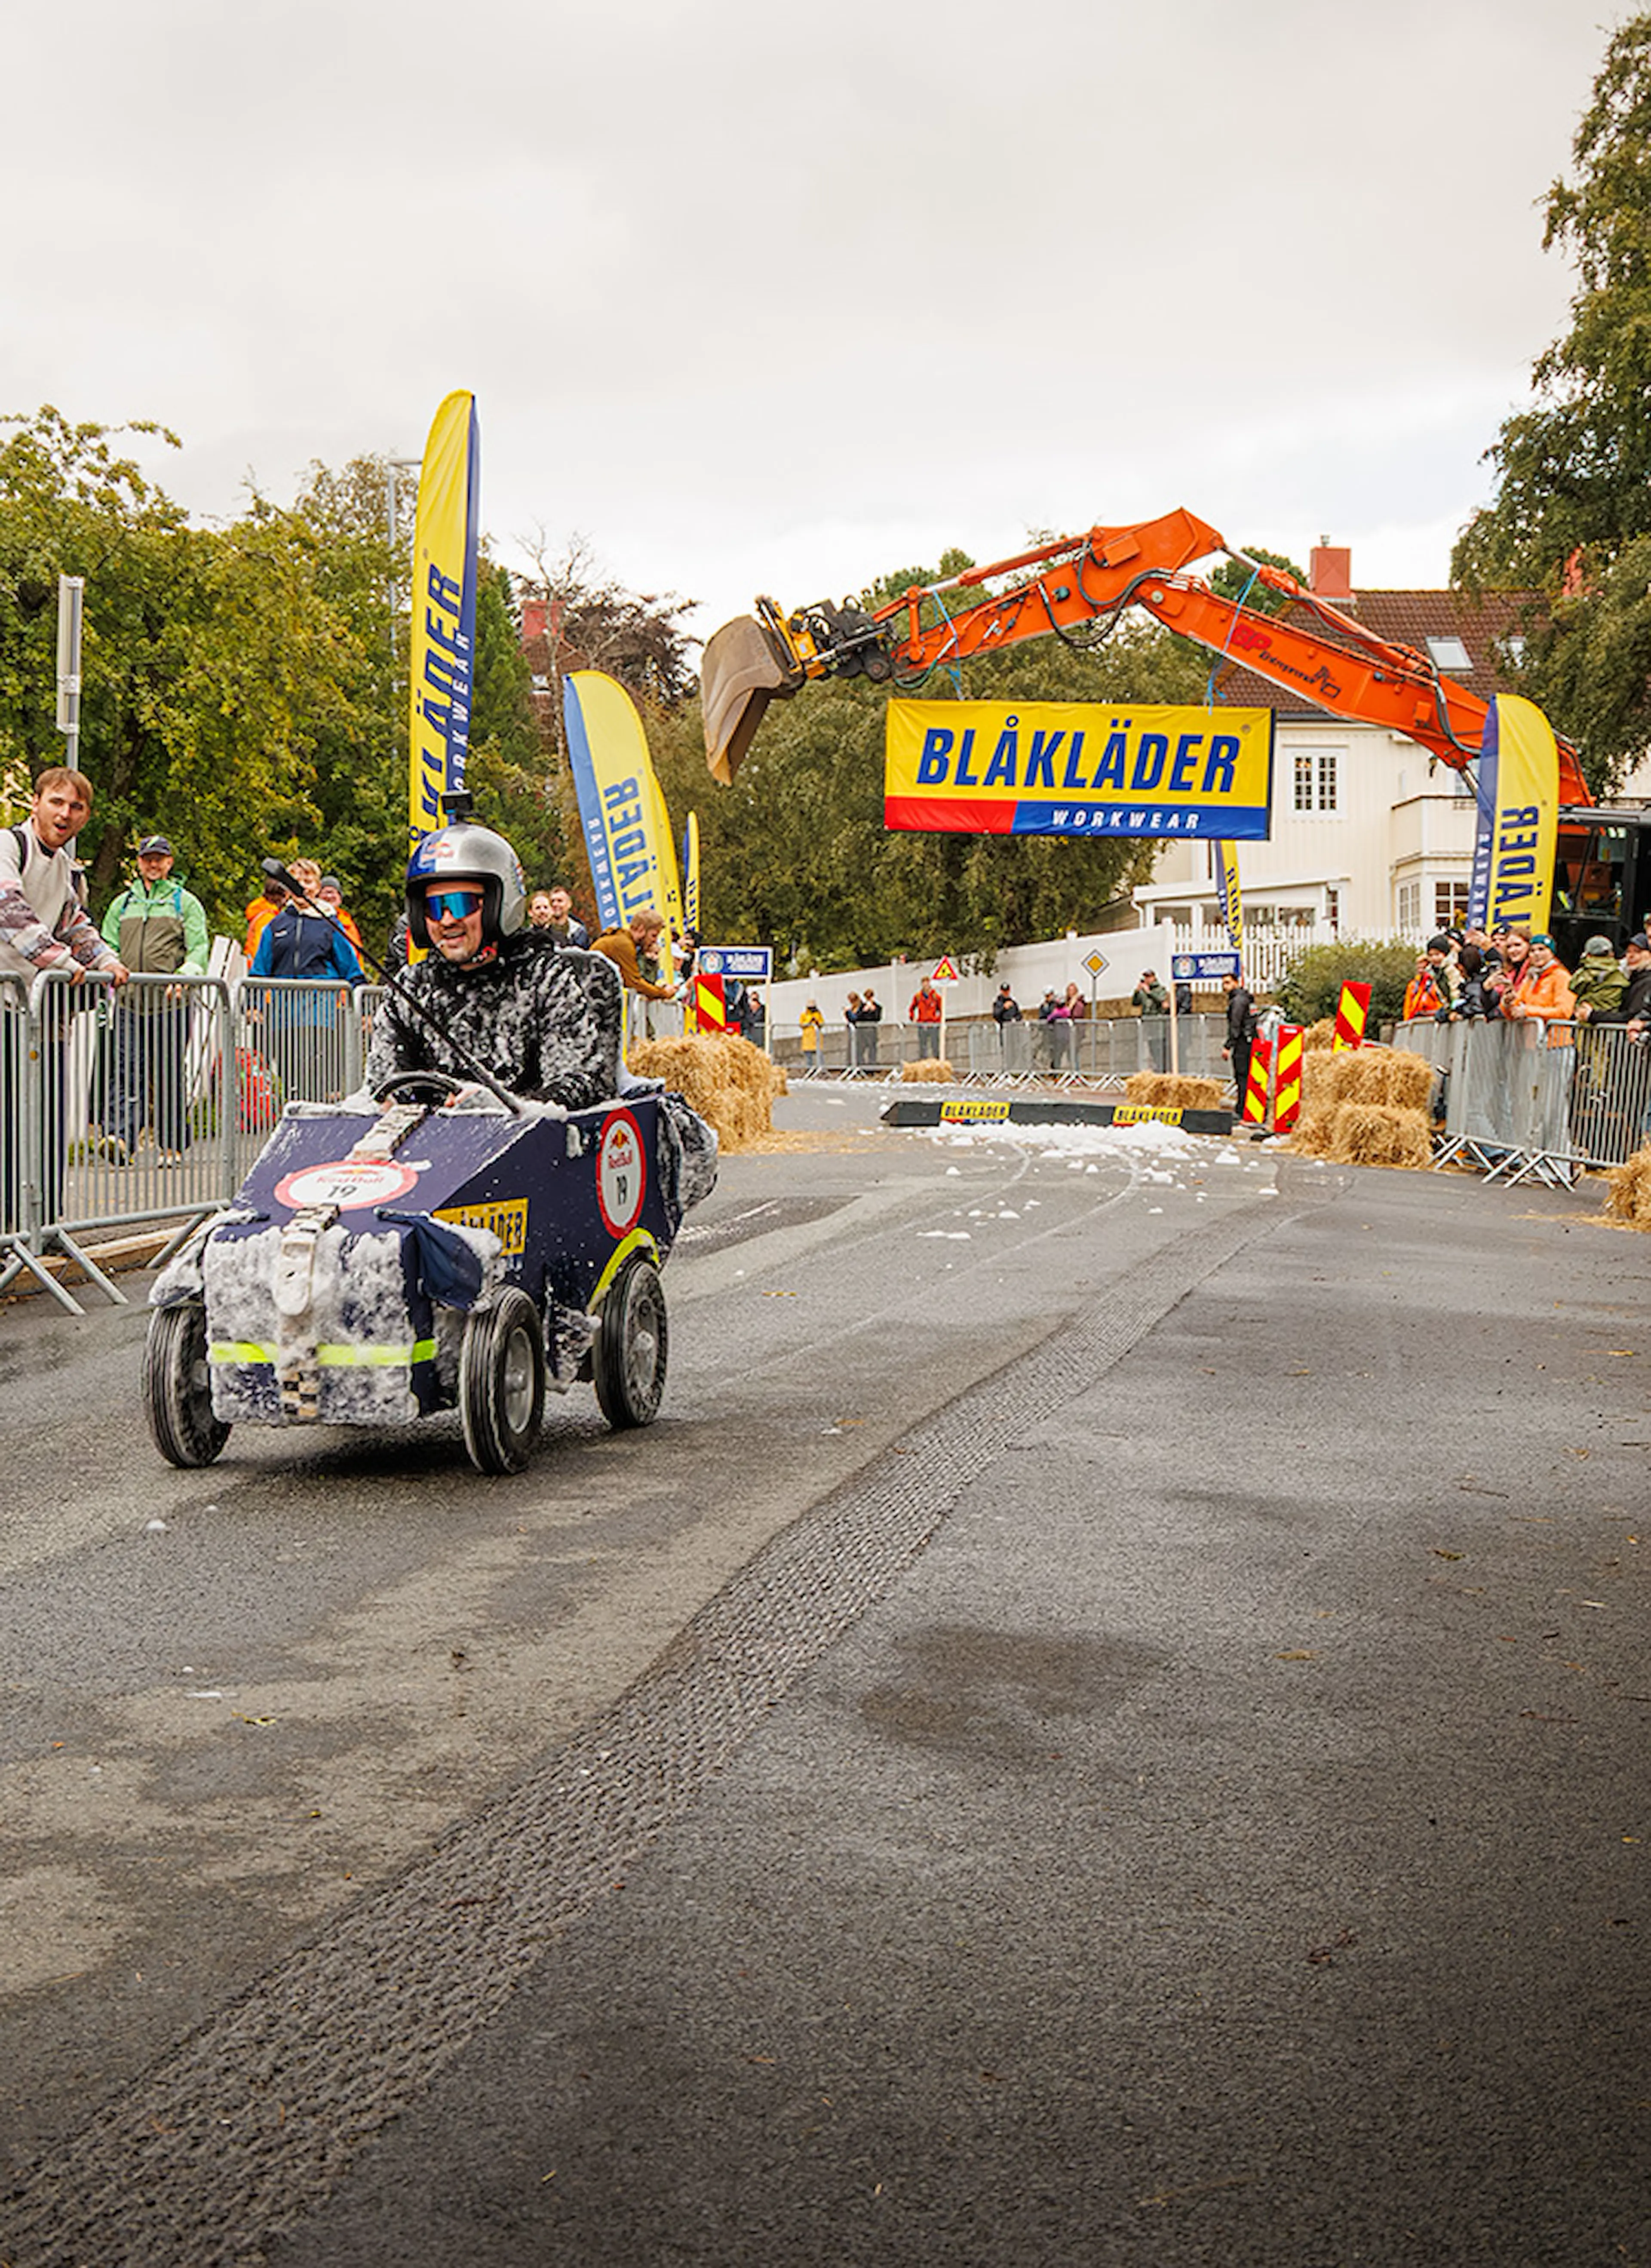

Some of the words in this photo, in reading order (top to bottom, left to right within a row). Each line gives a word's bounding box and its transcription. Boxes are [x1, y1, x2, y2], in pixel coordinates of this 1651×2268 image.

[916, 715, 1240, 793] BLÅKLÄDER
[1052, 809, 1200, 829] WORKWEAR
[327, 1184, 357, 1198] 19
